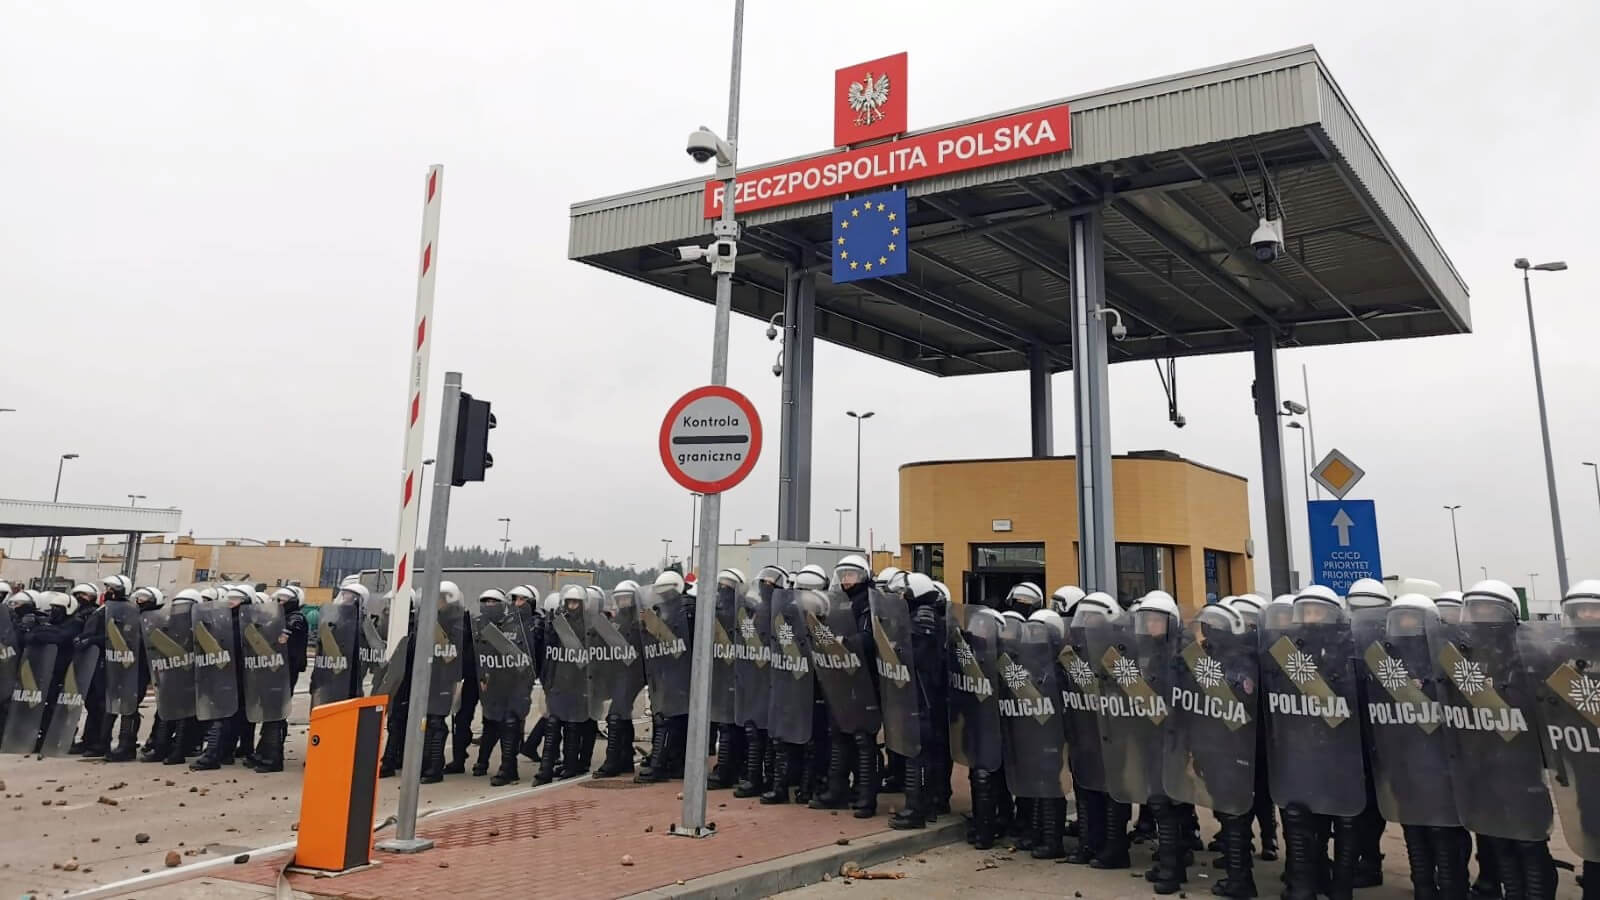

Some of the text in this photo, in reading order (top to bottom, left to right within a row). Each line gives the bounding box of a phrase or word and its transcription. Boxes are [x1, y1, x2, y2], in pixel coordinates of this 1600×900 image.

[713, 118, 1056, 209] RZECZPOSPOLITA POLSKA
[683, 415, 739, 428] Kontrola
[678, 449, 742, 465] graniczna
[1322, 570, 1373, 580] PRIORYTETY
[1323, 561, 1369, 570] PRIORYTET
[546, 645, 590, 664] POLICJA
[589, 645, 637, 660] POLICJA
[645, 638, 687, 659] POLICJA
[713, 643, 736, 659] ICJA
[152, 652, 195, 671] POLICJA
[315, 655, 348, 669] LICJA
[480, 653, 530, 668] POLICJA
[876, 657, 911, 682] LICJA
[999, 697, 1055, 717] POLICJA
[1062, 690, 1099, 712] POLIC
[1100, 695, 1168, 716] POLICJA
[1172, 687, 1247, 725] POLICJA
[1269, 692, 1351, 718] POLICJA
[1368, 701, 1442, 725] POLICJA
[1444, 704, 1529, 732] POLICJA
